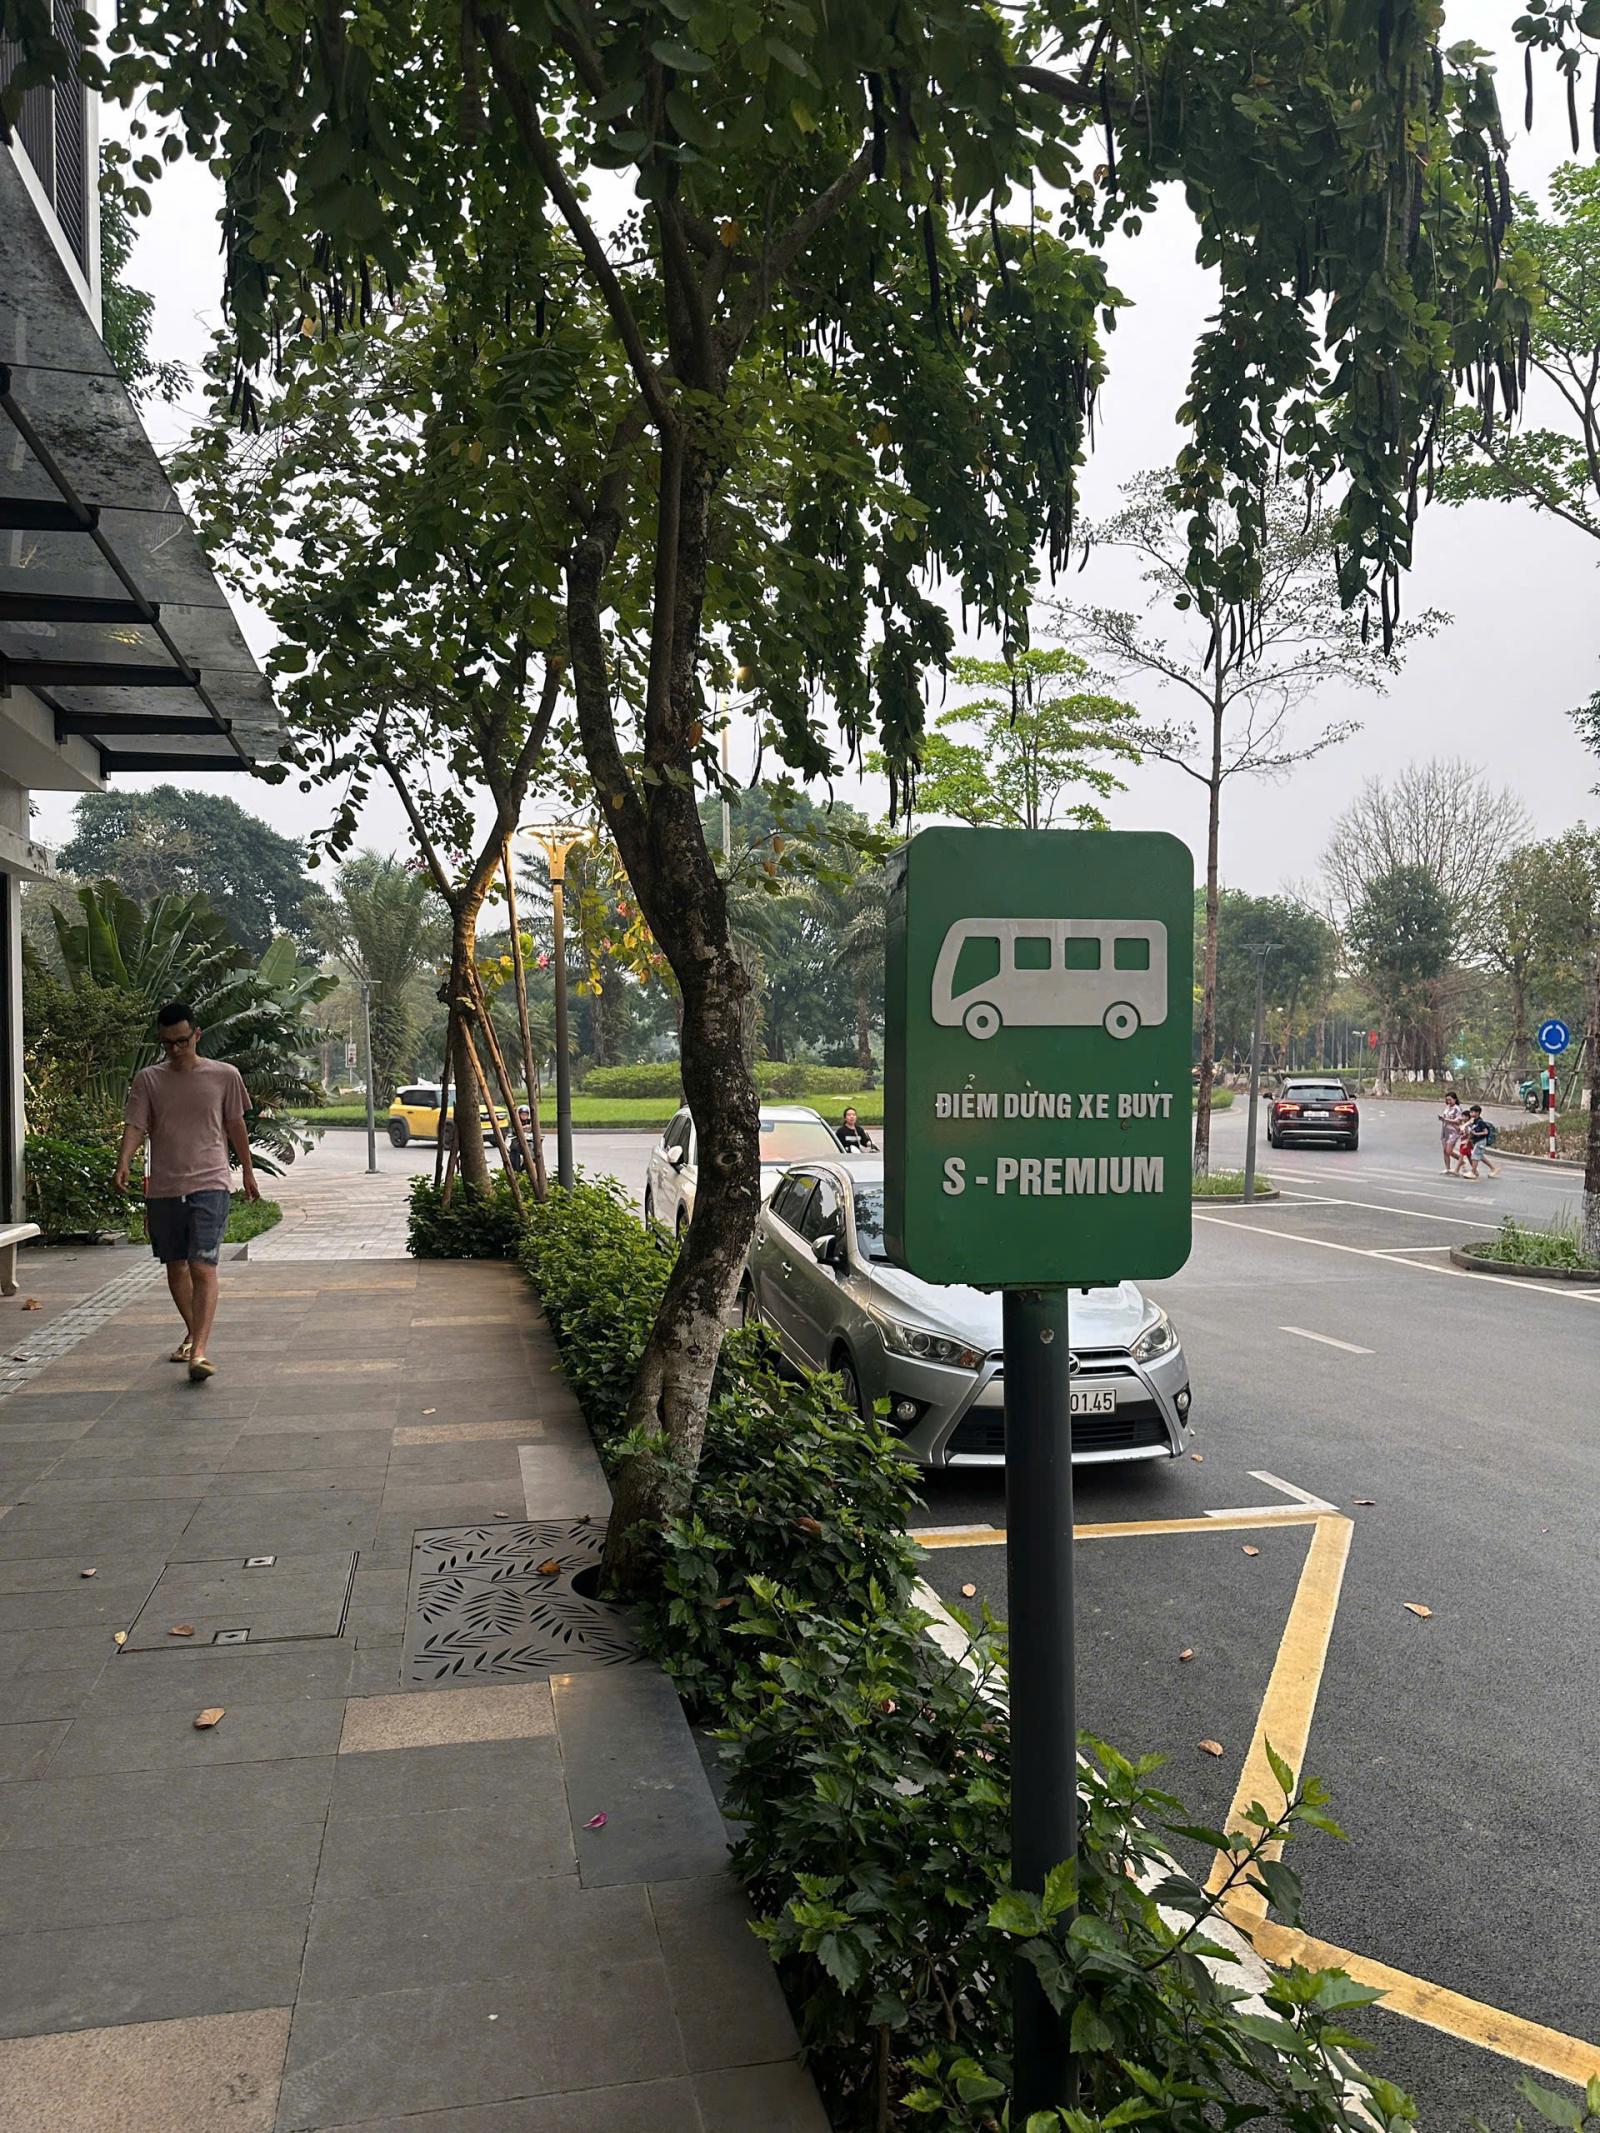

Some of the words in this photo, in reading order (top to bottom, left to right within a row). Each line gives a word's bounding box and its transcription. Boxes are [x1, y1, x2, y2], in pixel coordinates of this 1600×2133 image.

[935, 1073, 998, 1119] ĐIỂM
[1004, 1080, 1072, 1119] DỪNG
[1078, 1094, 1110, 1119] XE
[942, 1157, 966, 1196] S
[996, 1156, 1164, 1196] PREMIUM
